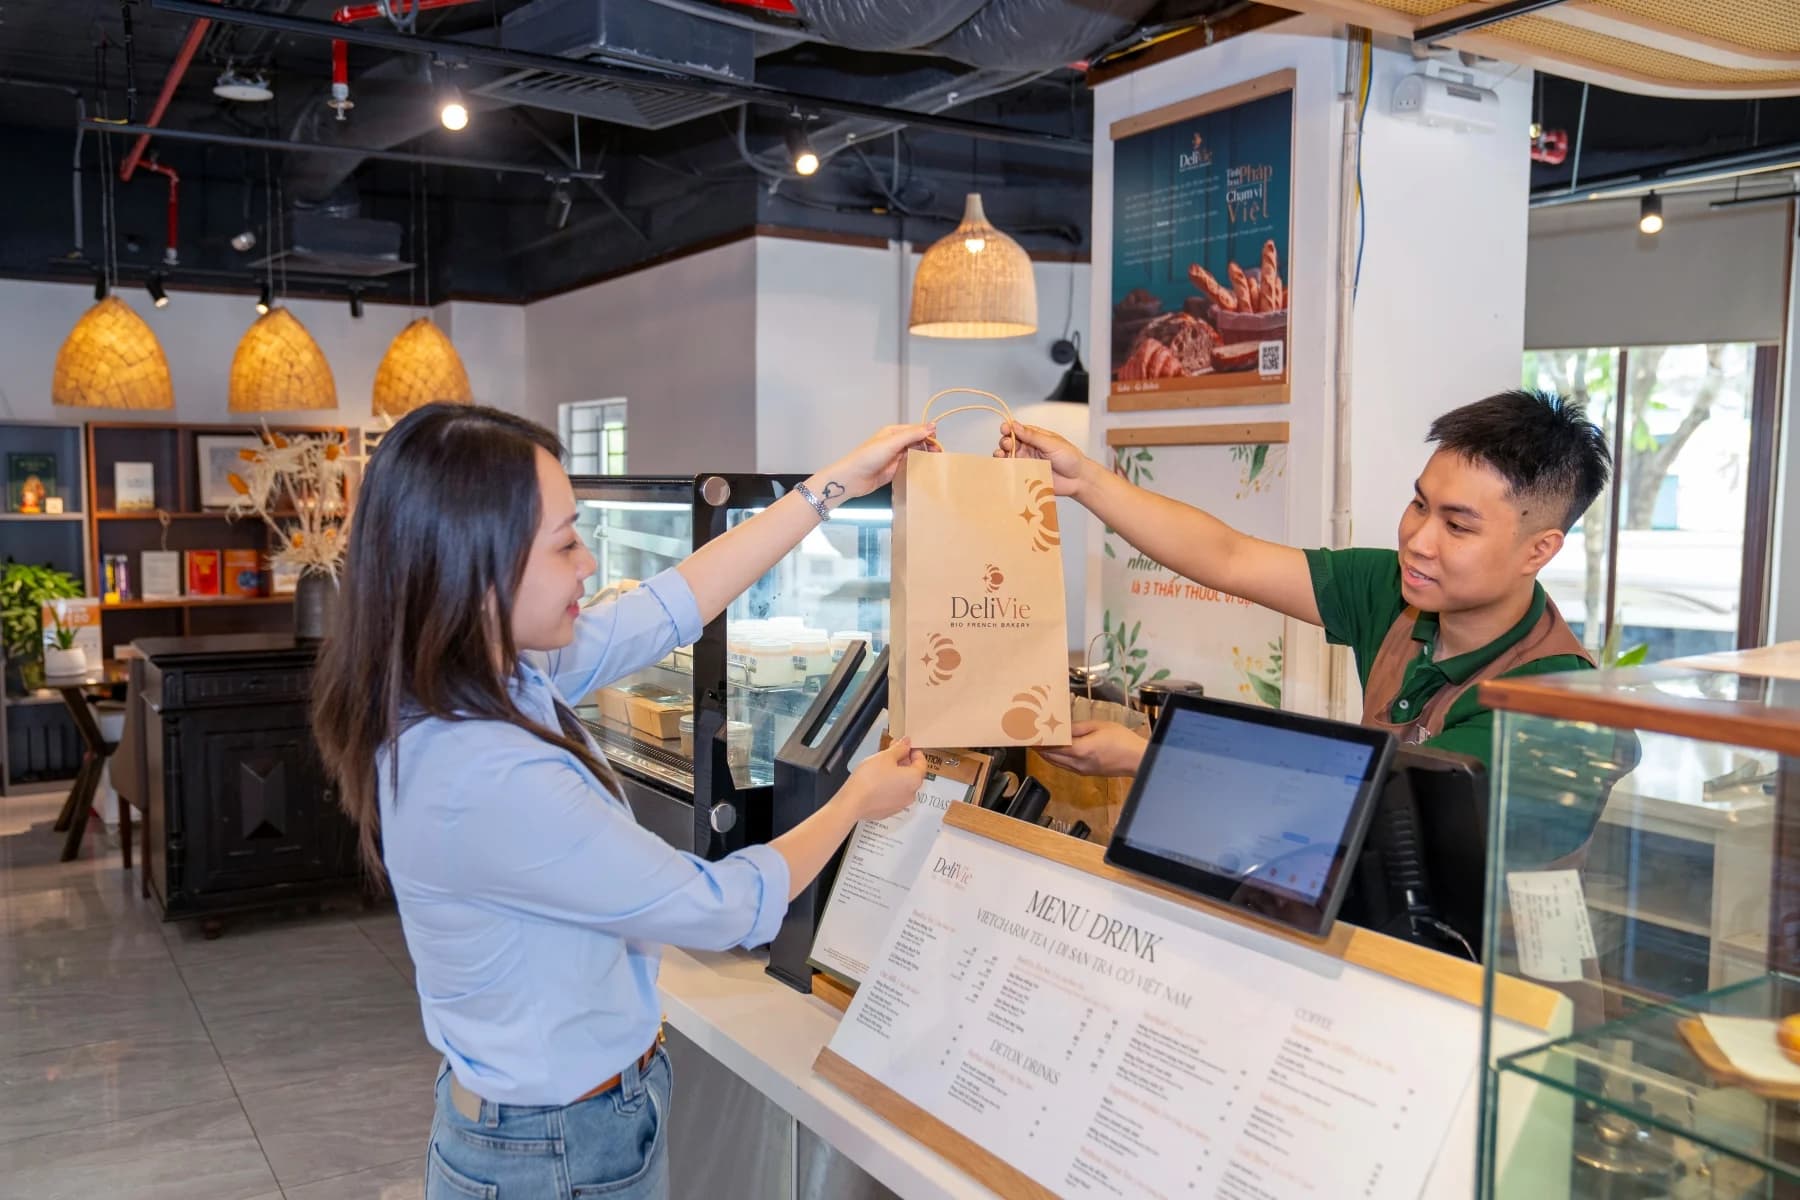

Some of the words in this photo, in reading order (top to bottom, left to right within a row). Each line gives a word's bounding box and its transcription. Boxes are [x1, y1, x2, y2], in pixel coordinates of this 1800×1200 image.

[1143, 581, 1151, 595] 3
[951, 596, 1031, 619] DeliVie
[932, 857, 973, 885] DeliVie
[977, 907, 1030, 940] VIETCHARM
[1025, 890, 1091, 932] MENU
[1087, 913, 1164, 963] DRINK
